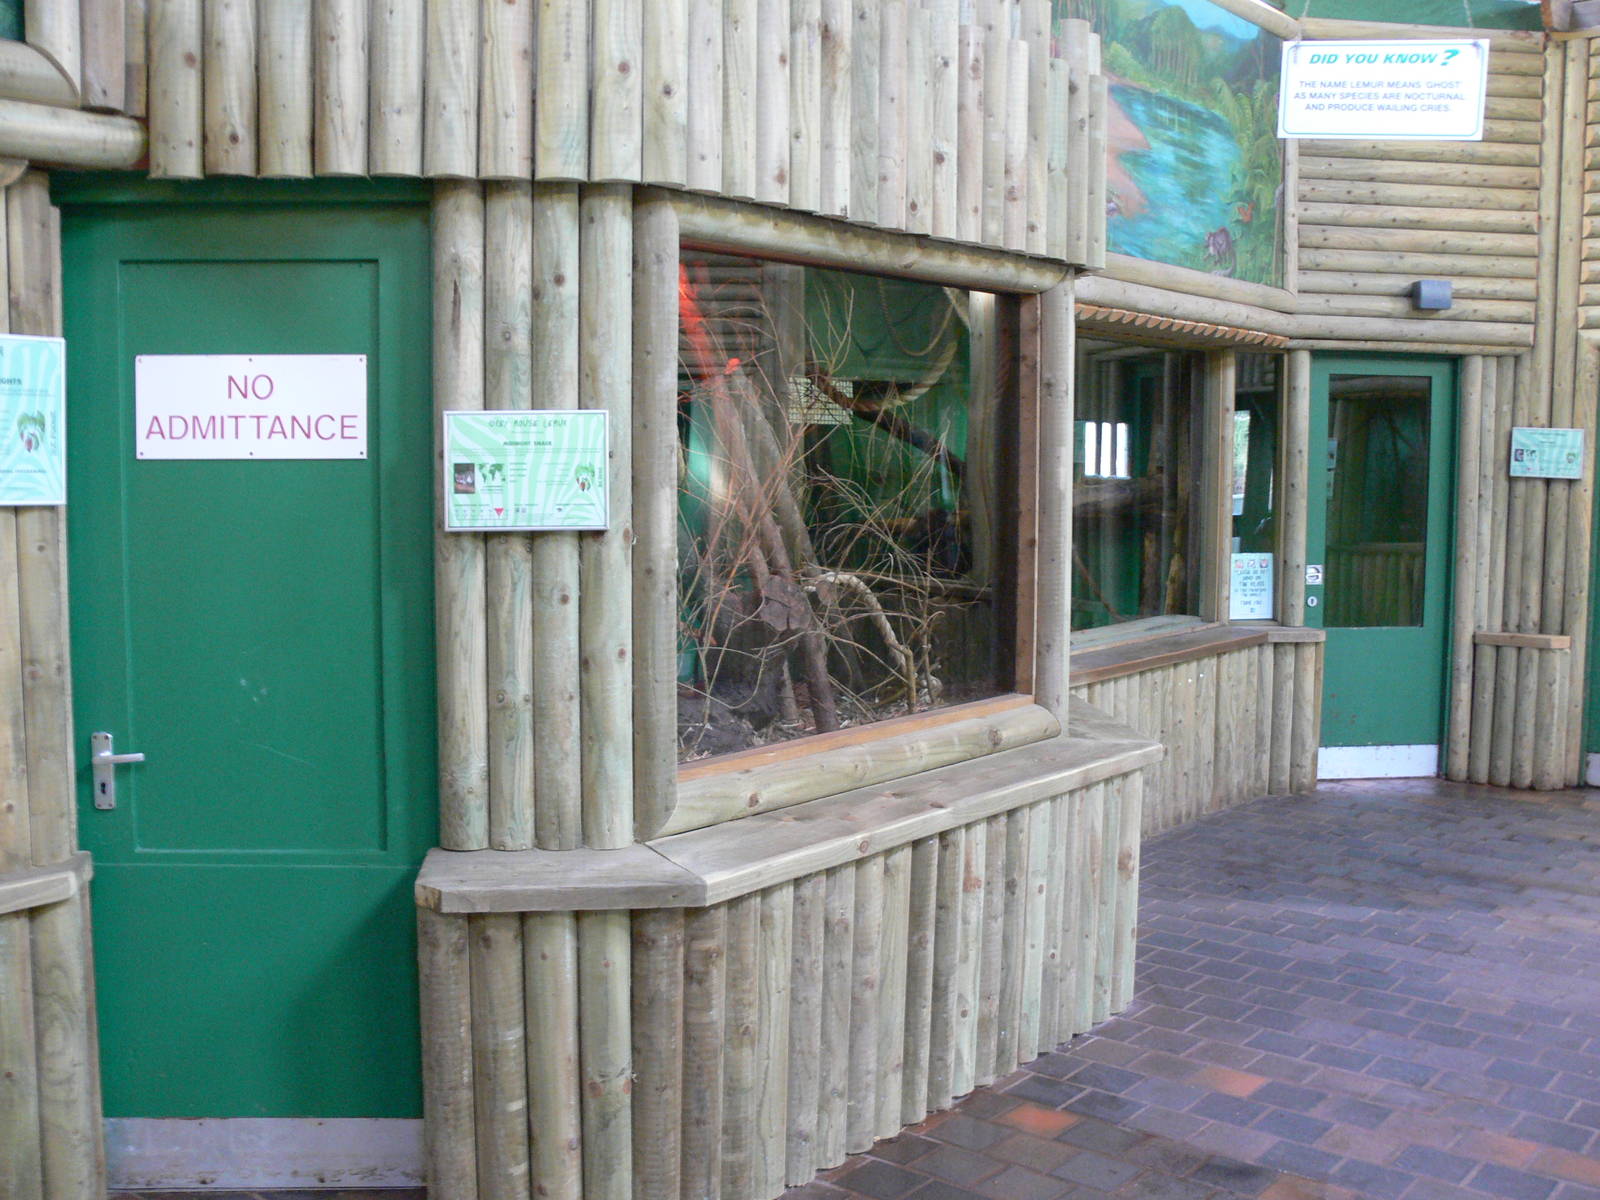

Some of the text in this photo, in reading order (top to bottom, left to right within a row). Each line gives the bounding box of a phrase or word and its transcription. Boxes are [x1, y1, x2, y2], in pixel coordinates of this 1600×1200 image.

[1309, 53, 1340, 64] DID
[1345, 53, 1380, 64] YOU
[1299, 80, 1317, 89] THE
[1320, 81, 1348, 89] NAME
[1350, 81, 1385, 89] LEMUR
[1387, 81, 1421, 89] MEANS
[1294, 92, 1465, 101] AS MANY SPECIES ARE NOCTURNAL
[1305, 103, 1325, 111] AND
[1327, 103, 1374, 111] PRODUCE
[1377, 104, 1417, 112] WAILING
[227, 373, 274, 400] NO
[145, 414, 358, 441] ADMITTANCE
